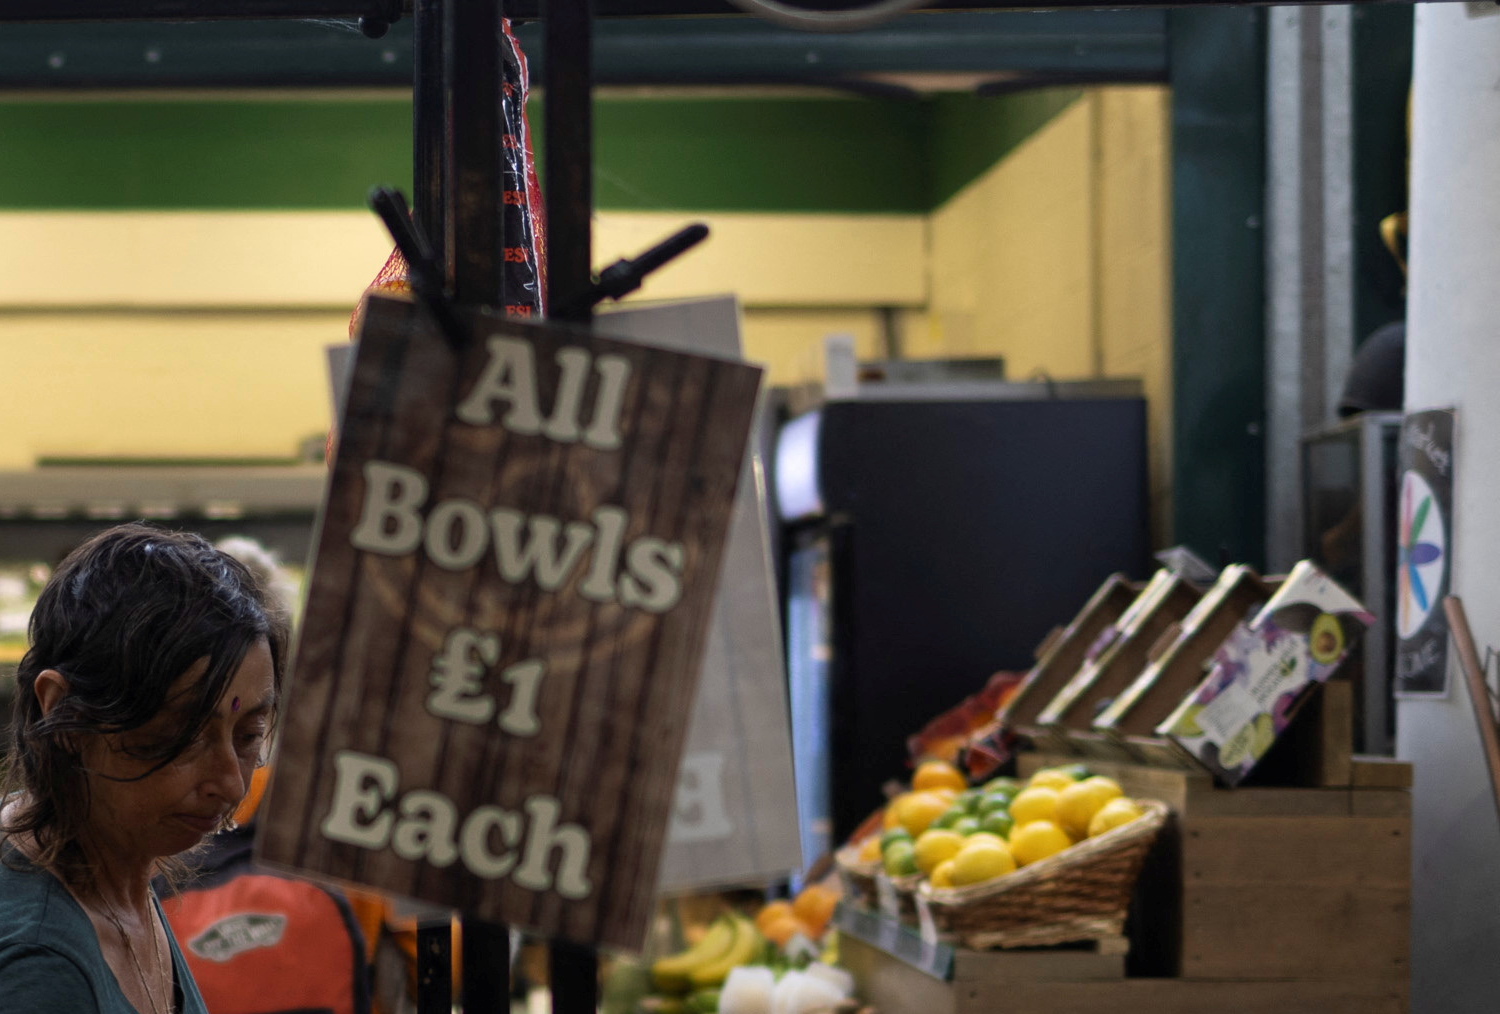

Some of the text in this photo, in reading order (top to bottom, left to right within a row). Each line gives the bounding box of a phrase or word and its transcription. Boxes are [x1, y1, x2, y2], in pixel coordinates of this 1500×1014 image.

[457, 335, 631, 449] All
[352, 460, 684, 613] Bowls
[427, 628, 545, 736] £1
[321, 750, 592, 899] Each
